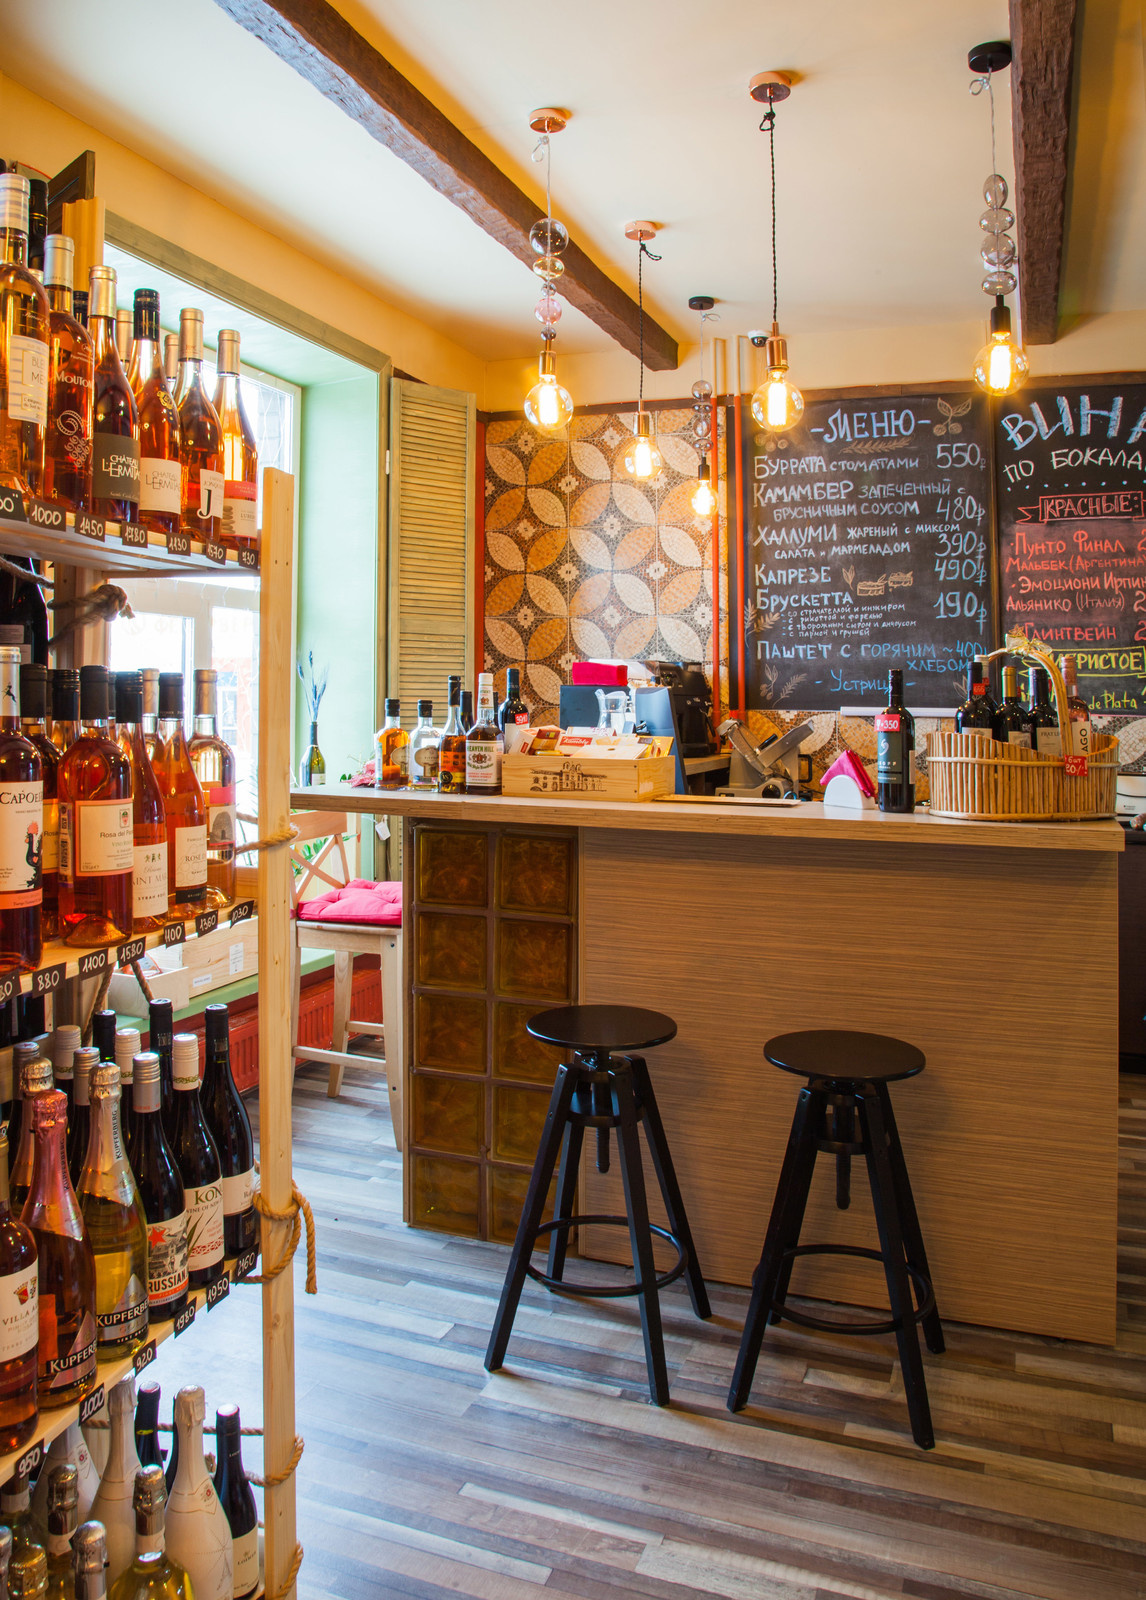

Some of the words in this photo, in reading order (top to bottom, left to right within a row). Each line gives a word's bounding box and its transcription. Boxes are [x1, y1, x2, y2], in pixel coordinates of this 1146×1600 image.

[754, 455, 827, 479] БУРРАТА
[1051, 448, 1146, 470] БОКАЛА
[754, 481, 854, 507] КАМАМБЕР
[32, 504, 62, 525] 1000
[80, 516, 104, 536] 1450
[755, 562, 831, 586] КАПРЕЗЕ
[82, 953, 106, 973] 1100
[38, 970, 59, 992] 880
[111, 1110, 122, 1160] KUPFERBERG
[207, 1277, 229, 1305] 1950
[176, 1305, 196, 1332] 1980
[136, 1347, 153, 1371] 920
[81, 1388, 104, 1421] 1000
[18, 1447, 41, 1478] 950
